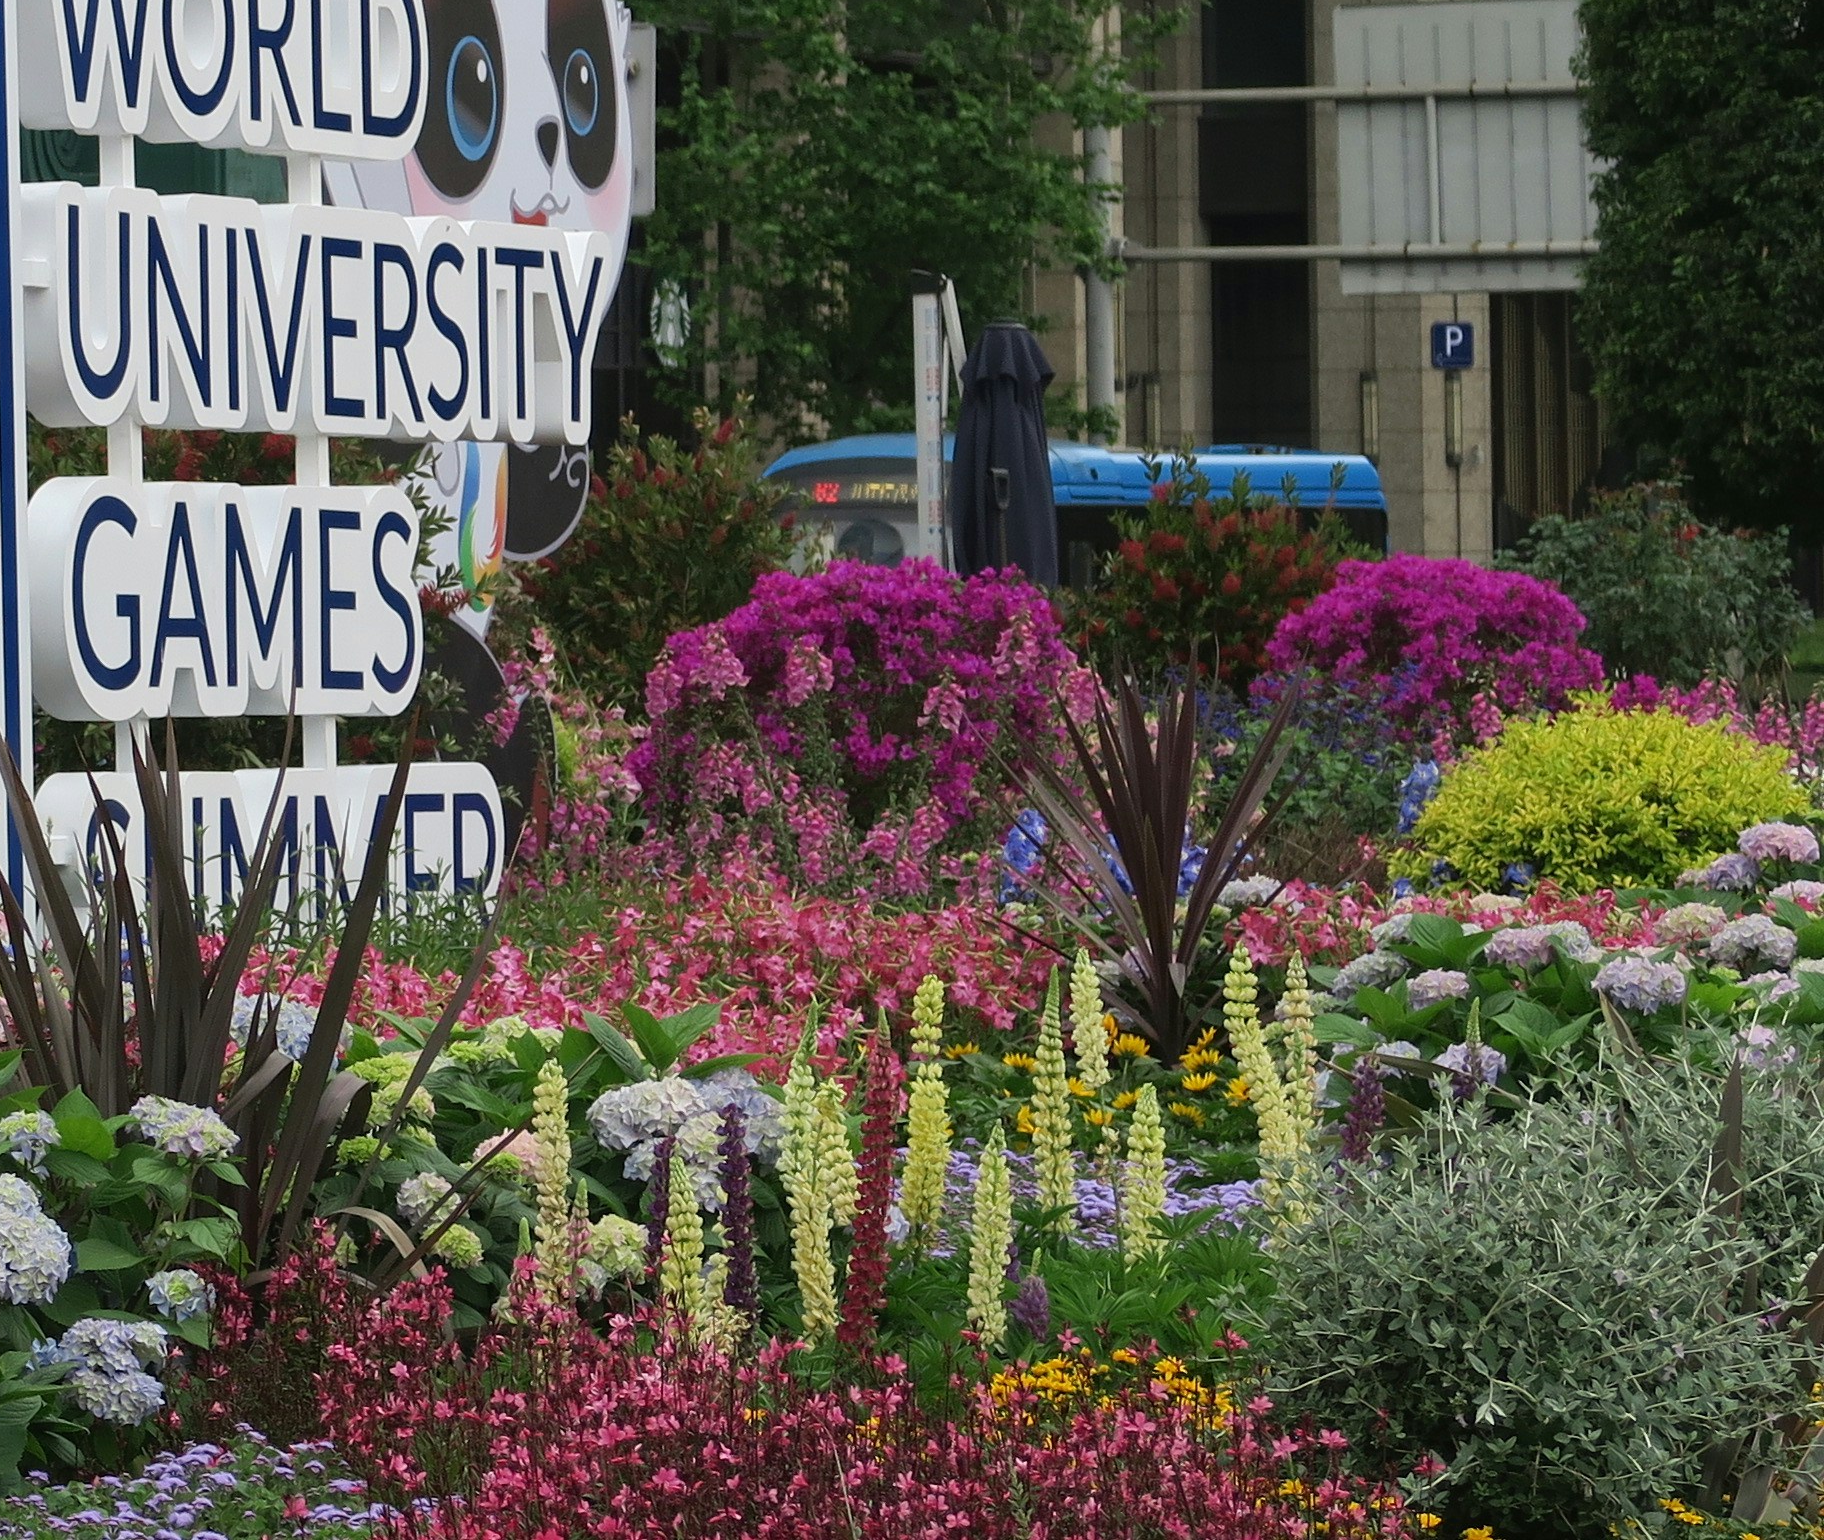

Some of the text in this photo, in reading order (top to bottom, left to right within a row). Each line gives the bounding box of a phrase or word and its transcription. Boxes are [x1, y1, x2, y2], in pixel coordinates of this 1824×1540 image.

[67, 204, 603, 423] UNIVERSITY
[1446, 325, 1463, 358] P
[72, 495, 415, 693] GAMES
